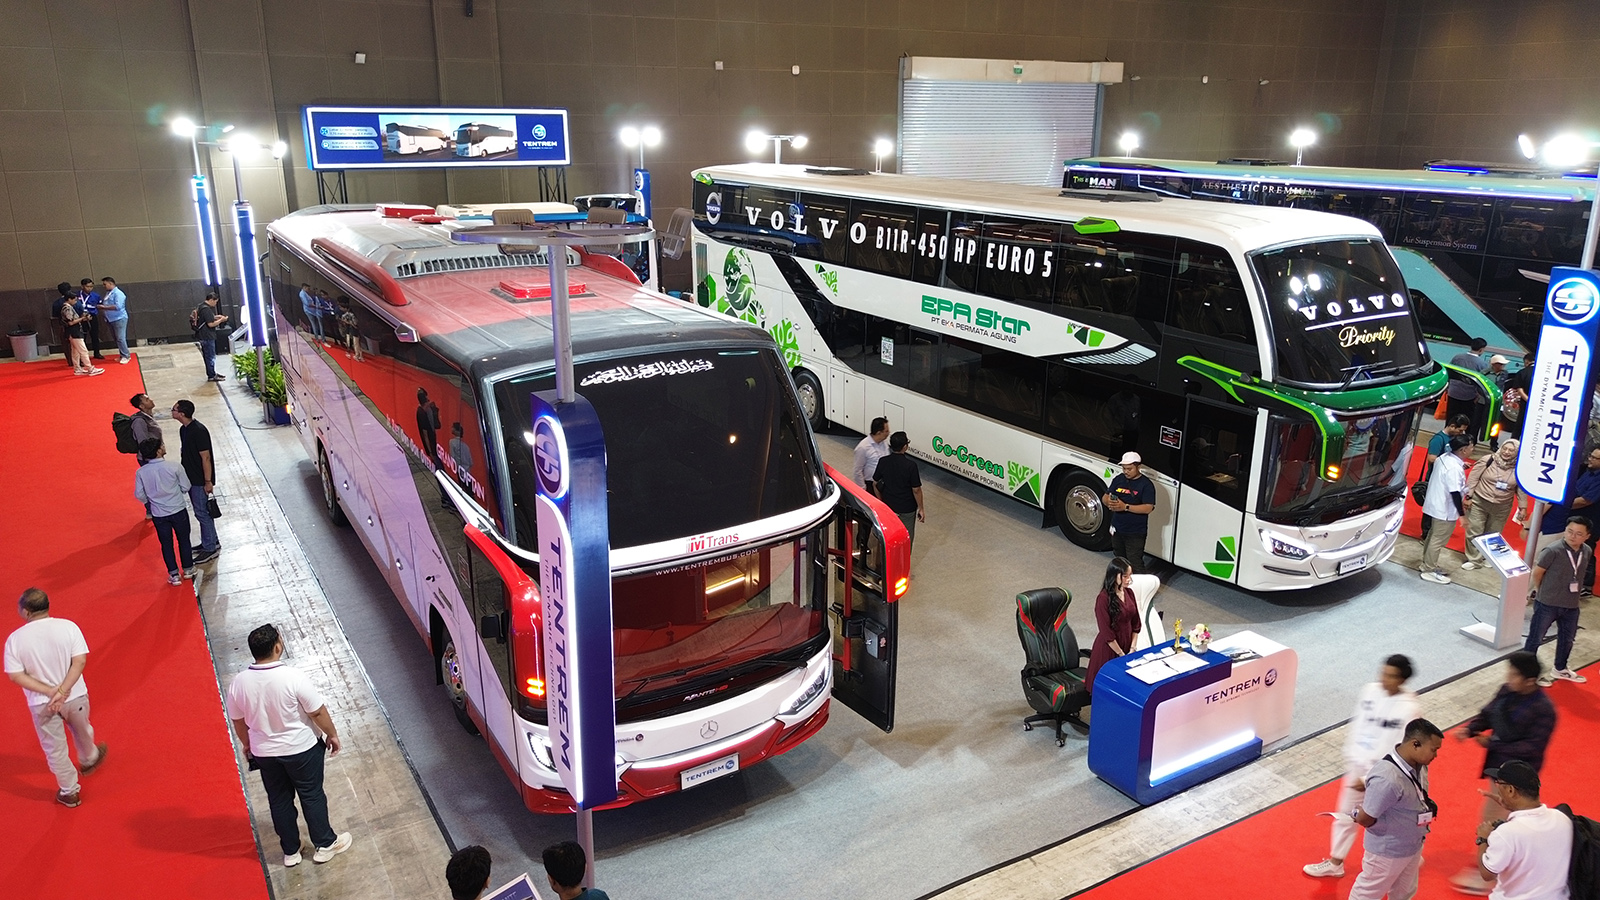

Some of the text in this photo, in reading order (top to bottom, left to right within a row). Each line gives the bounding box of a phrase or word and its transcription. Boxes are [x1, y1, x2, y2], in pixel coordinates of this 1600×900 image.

[1089, 177, 1117, 187] MAN
[1201, 182, 1260, 192] AESTHETIC
[745, 206, 1053, 277] VOLVO B11R-450 HP EURO 5
[1414, 237, 1451, 248] Suspension
[1452, 241, 1478, 250] System
[921, 294, 1031, 336] EPA Star
[1299, 293, 1404, 321] VOLVO
[931, 316, 1017, 344] PT EKA PERMATA AGUNG
[1338, 325, 1396, 348] Priority
[1538, 377, 1549, 412] DYNAMIC
[1537, 345, 1578, 485] TENTREM
[1530, 415, 1543, 460] TECHNOLOGY
[932, 436, 1004, 479] Go-Green
[932, 456, 949, 466] ANTAR
[949, 461, 961, 473] KOTA
[962, 467, 980, 480] ANTAR
[980, 475, 1005, 491] PROPINSI
[655, 548, 758, 576] WWW.TENTREMBUS.COM
[551, 537, 571, 771] TENTREM
[1205, 676, 1261, 704] TENTREM
[685, 764, 725, 782] TENTREM
